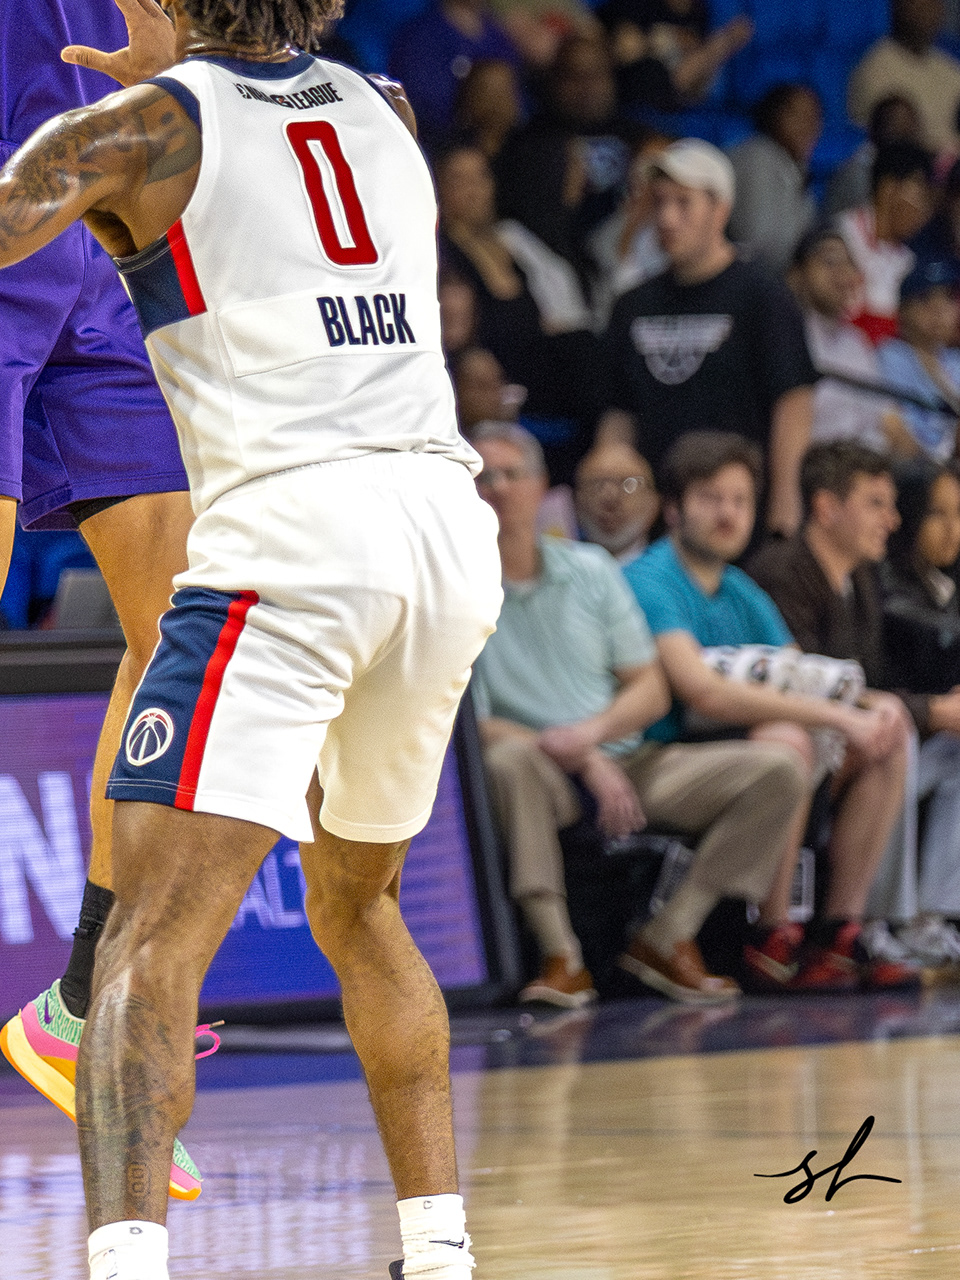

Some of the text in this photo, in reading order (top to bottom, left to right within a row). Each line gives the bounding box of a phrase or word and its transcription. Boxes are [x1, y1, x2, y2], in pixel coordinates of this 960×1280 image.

[286, 82, 344, 111] LEAGUE
[285, 119, 380, 267] 0
[316, 293, 417, 347] BLACK
